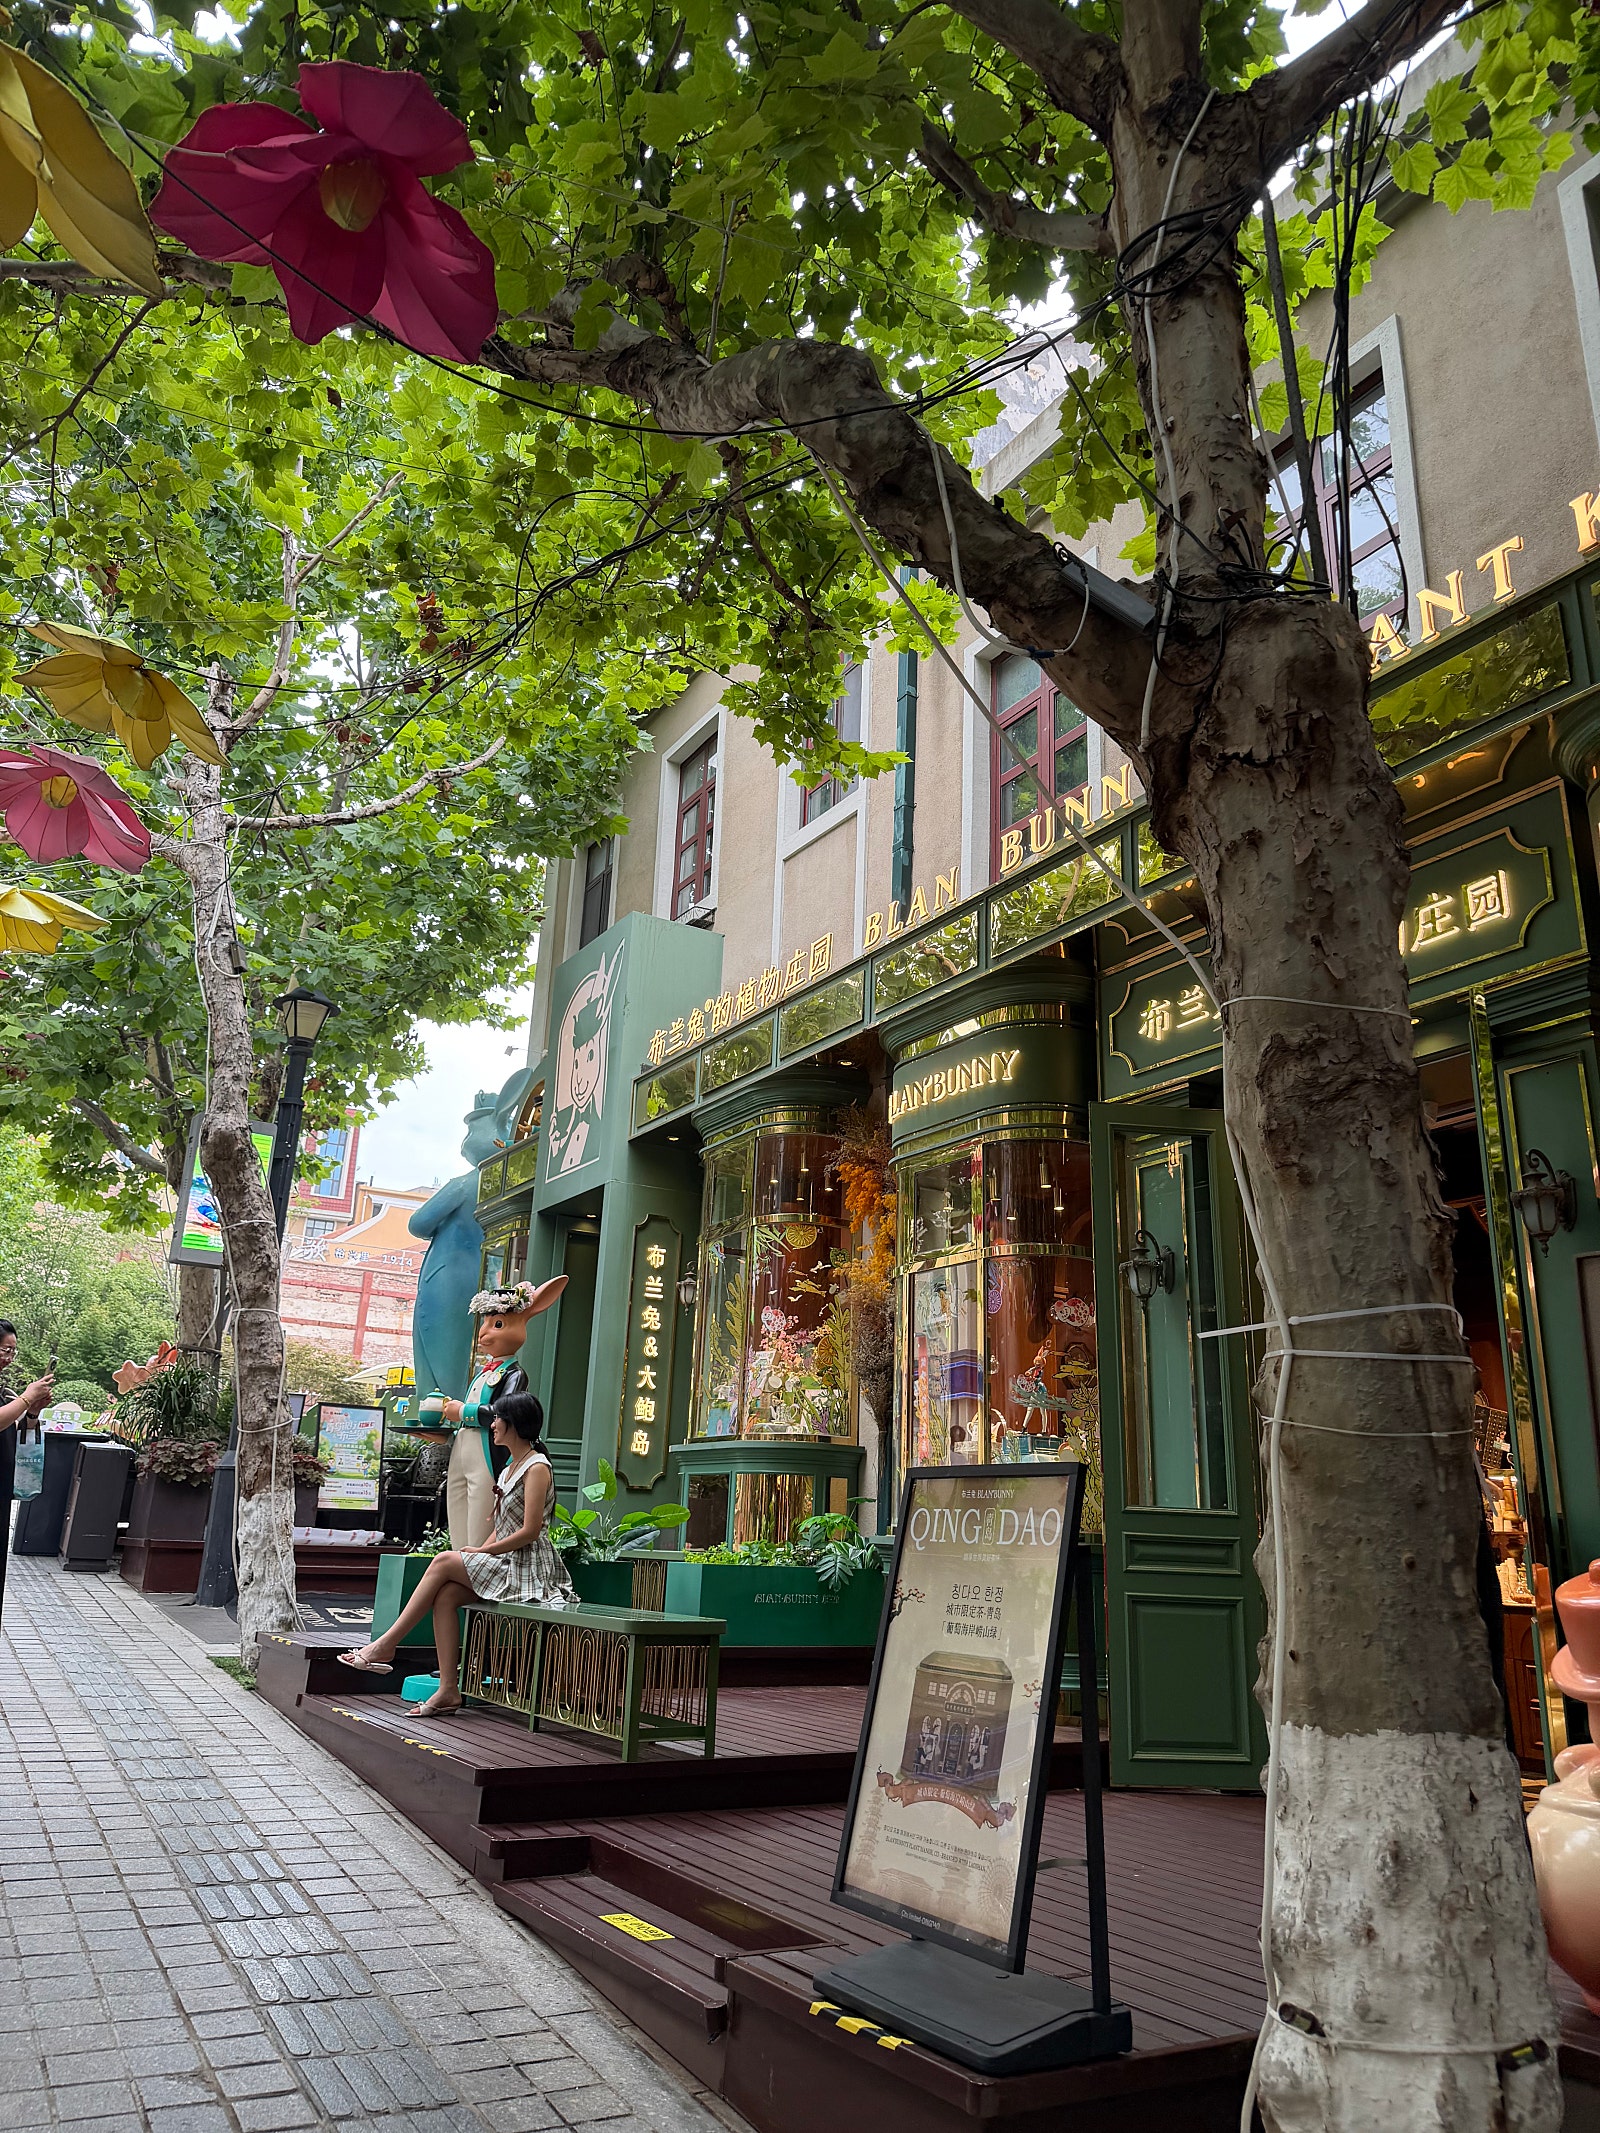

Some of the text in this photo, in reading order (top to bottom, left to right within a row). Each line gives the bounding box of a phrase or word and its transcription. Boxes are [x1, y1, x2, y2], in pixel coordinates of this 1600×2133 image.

[1370, 535, 1524, 674] ANT
[863, 763, 1134, 950] BLAN BUNN
[1399, 869, 1511, 956] 庄园
[1138, 984, 1222, 1041] 布兰
[382, 1254, 413, 1267] 1914
[630, 1244, 667, 1457] 布兰兔&大鲍岛
[910, 1507, 1061, 1551] QING DAO
[951, 1583, 1004, 1603] 칭다오 한정
